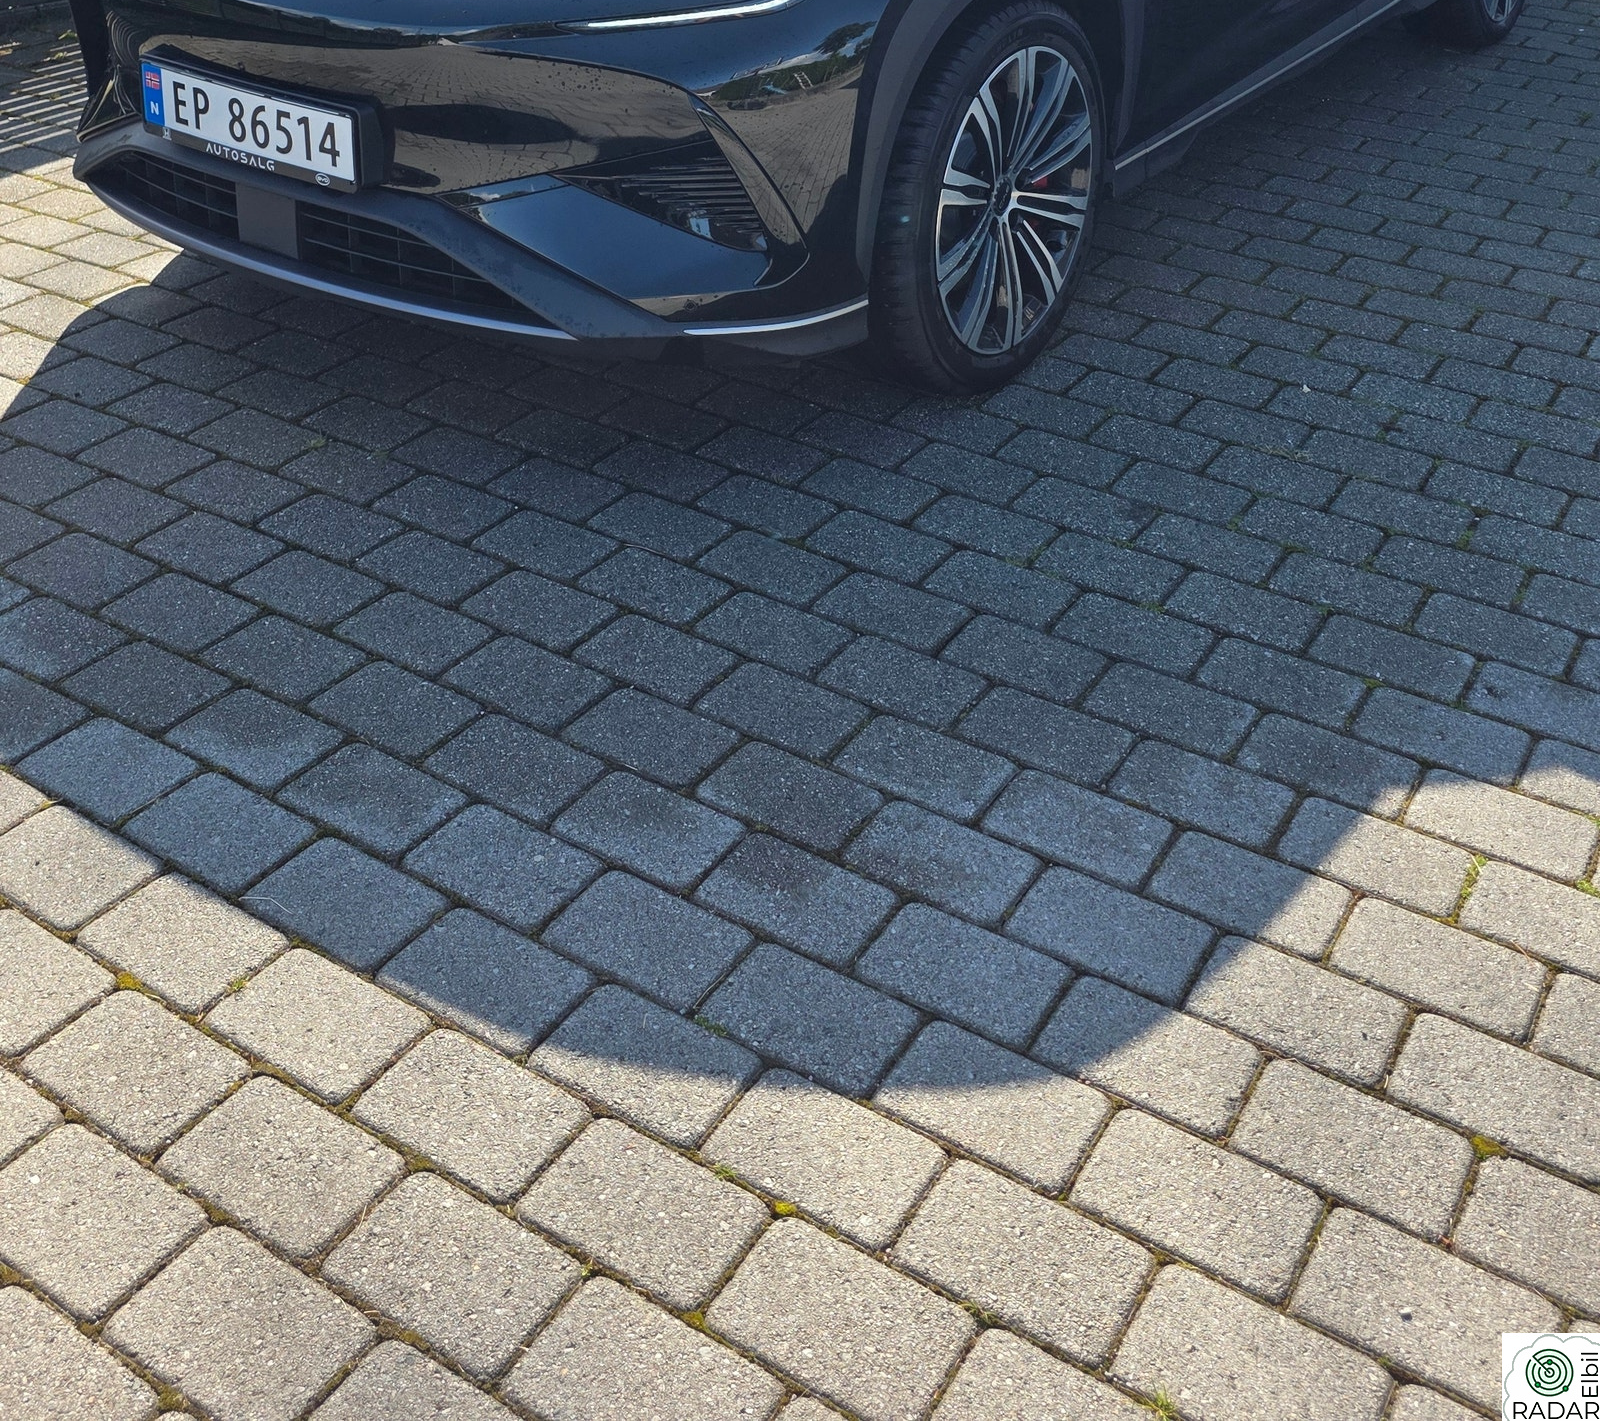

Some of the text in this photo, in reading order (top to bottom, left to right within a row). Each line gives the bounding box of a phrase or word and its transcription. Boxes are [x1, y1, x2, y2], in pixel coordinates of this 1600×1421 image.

[150, 101, 159, 115] N
[172, 80, 340, 168] EP 86514
[205, 142, 275, 172] AUTOSALG
